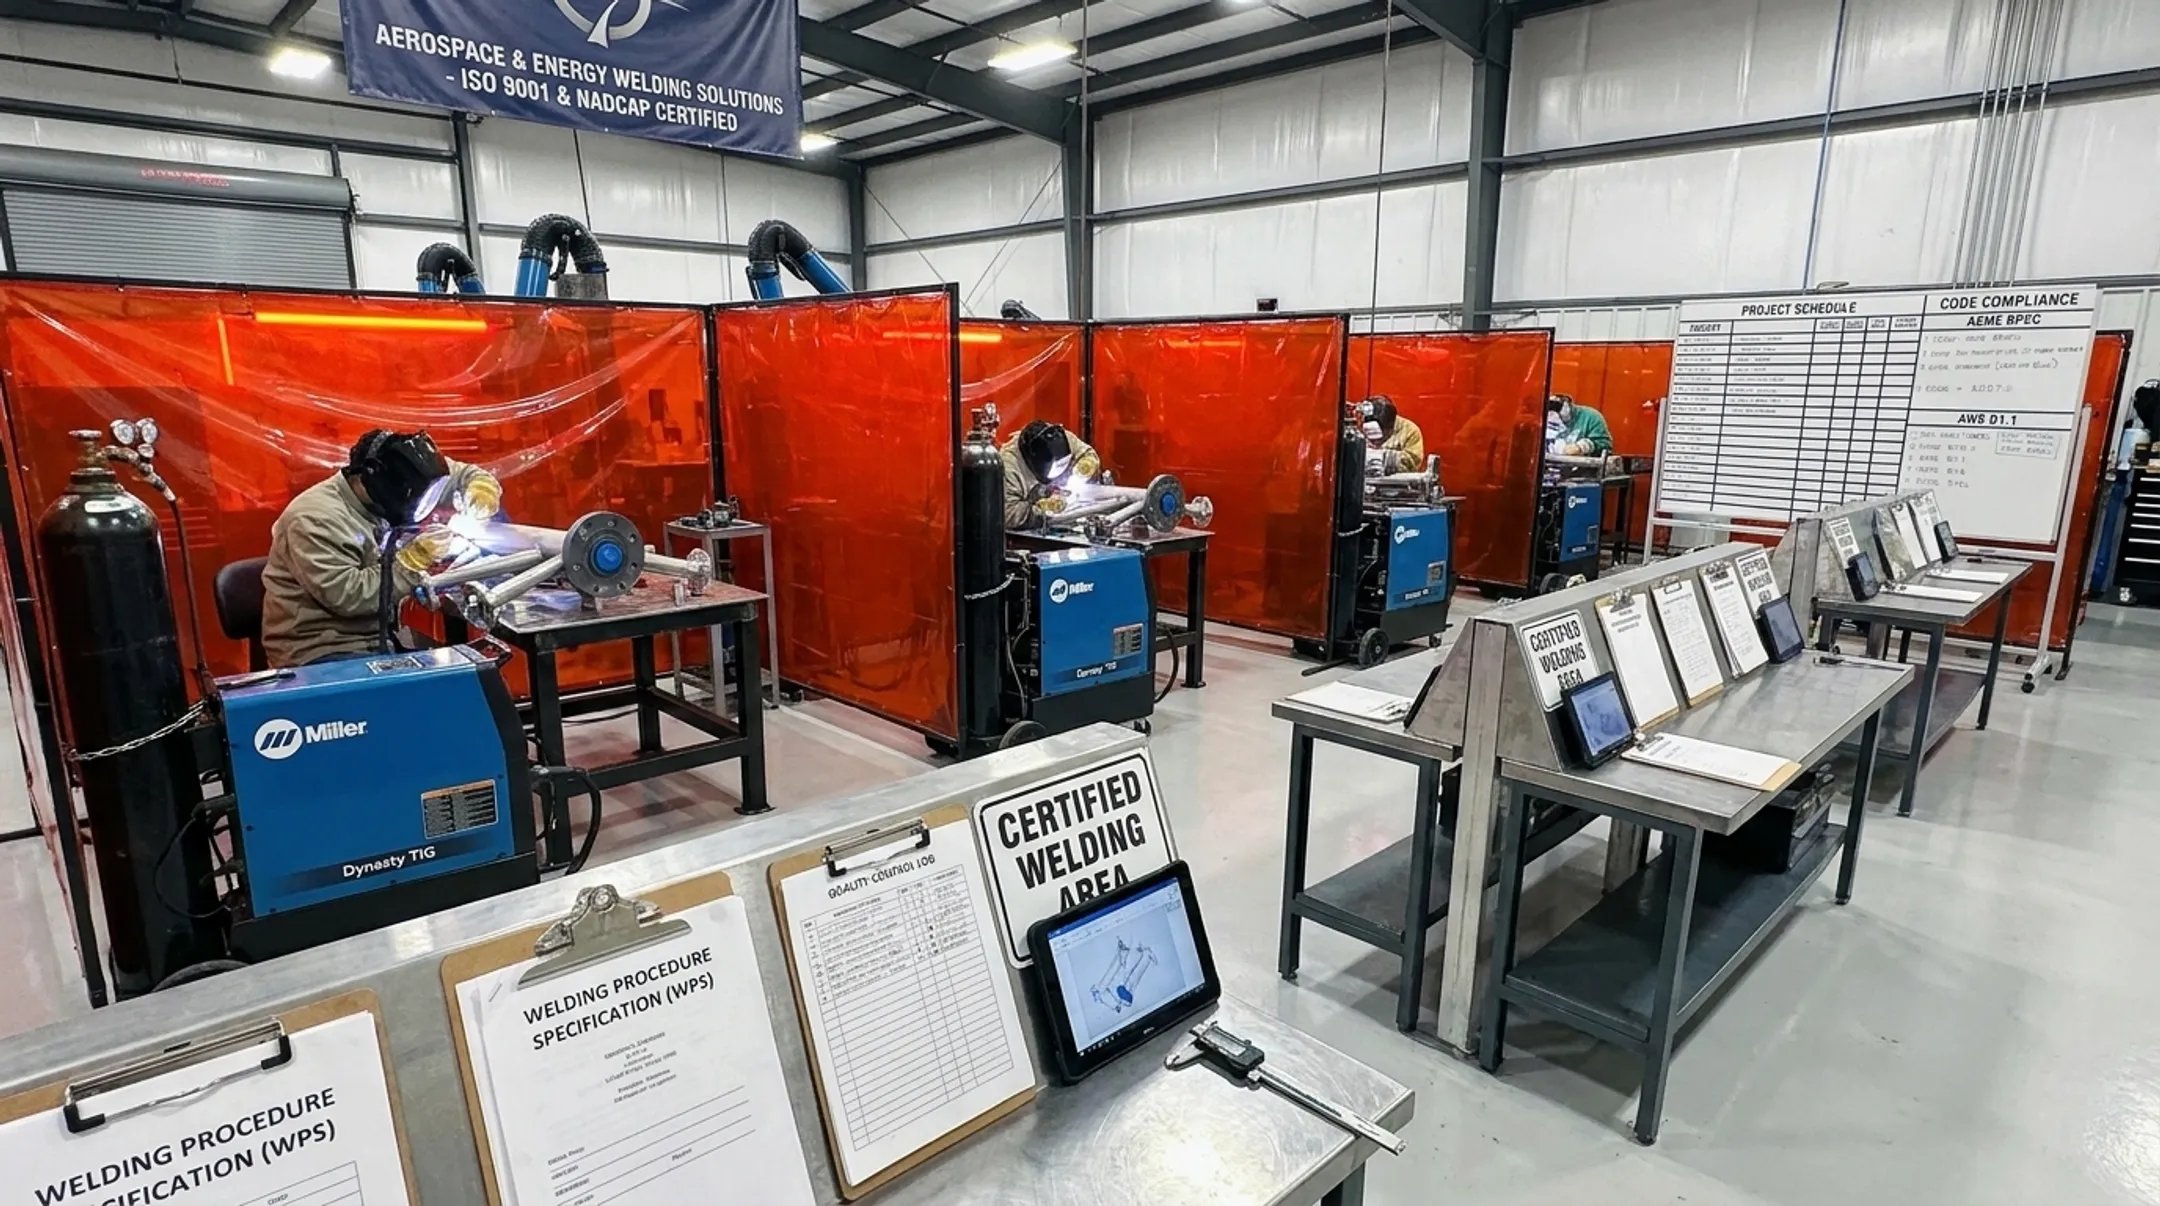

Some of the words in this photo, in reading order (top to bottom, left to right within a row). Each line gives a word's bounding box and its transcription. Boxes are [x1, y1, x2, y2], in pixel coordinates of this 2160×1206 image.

[375, 23, 505, 67] AEROSPACE
[512, 49, 527, 71] &
[533, 52, 606, 85] ENERGY
[612, 66, 692, 100] WELDING
[696, 82, 784, 115] SOLUTIONS
[461, 72, 496, 93] ISO
[503, 80, 549, 104] 9001
[556, 86, 571, 107] &
[576, 92, 651, 118] NADCAP
[655, 103, 738, 132] CERTIFIED
[1741, 304, 1791, 316] PROJECT
[1940, 297, 1977, 310] CODE
[1981, 292, 2079, 308] COMPLIANCE
[1967, 315, 2002, 327] AEME
[1957, 413, 1985, 425] AWS
[1989, 414, 2017, 427] D1.1
[305, 720, 367, 743] Miller
[997, 770, 1142, 849] CERTIFIED
[342, 855, 405, 878] Dynasty
[408, 845, 436, 862] TIG
[1016, 812, 1146, 890] WELDING
[1060, 863, 1130, 912] AREA
[523, 983, 609, 1025] WELDING
[613, 947, 713, 994] PROCEDURE
[532, 995, 663, 1051] SPECIFICATION
[666, 970, 715, 1014] (WPS)
[35, 1145, 172, 1206] WELDING
[181, 1088, 335, 1157] PROCEDURE
[262, 1119, 336, 1165] (WPS)
